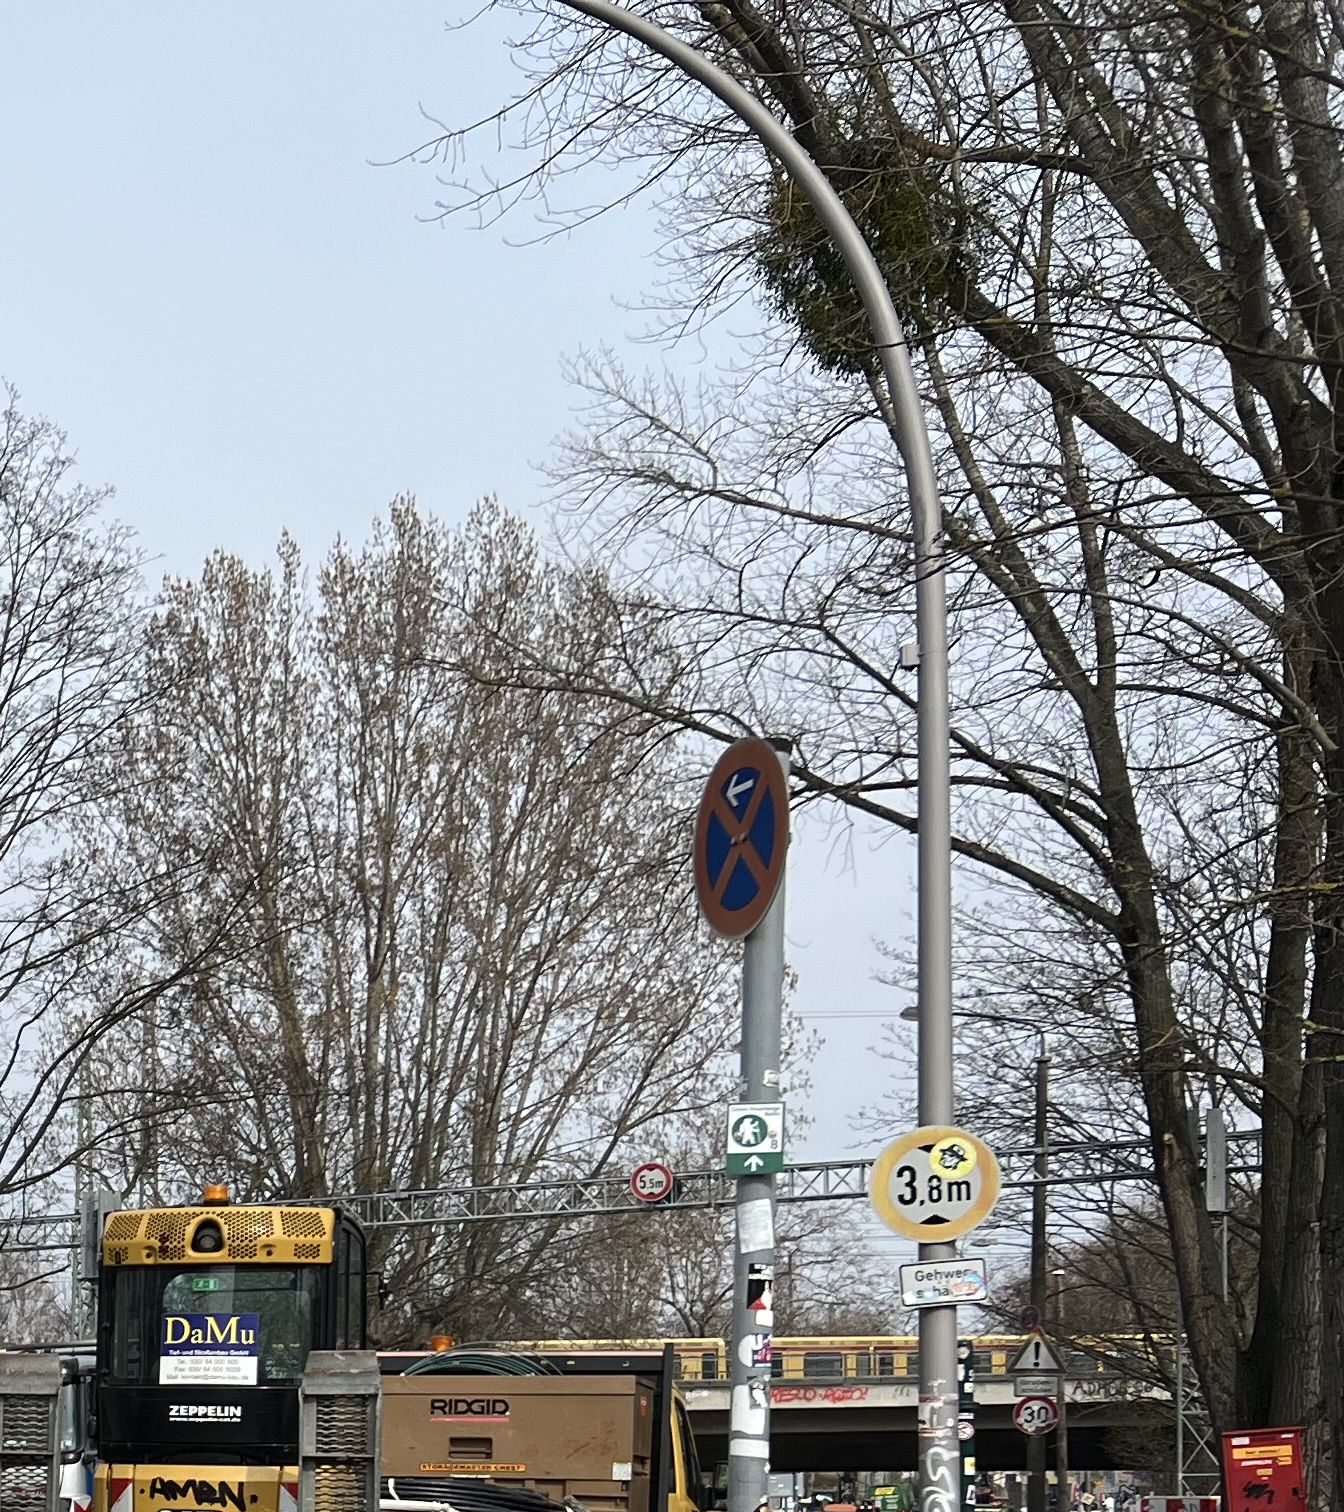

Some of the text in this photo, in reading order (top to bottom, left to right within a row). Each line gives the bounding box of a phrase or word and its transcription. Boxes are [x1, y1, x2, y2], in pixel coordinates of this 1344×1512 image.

[164, 1316, 255, 1345] DaMu
[169, 1405, 242, 1417] ZEPPELIN
[430, 1399, 509, 1415] RIDGID
[1023, 1406, 1049, 1424] 30
